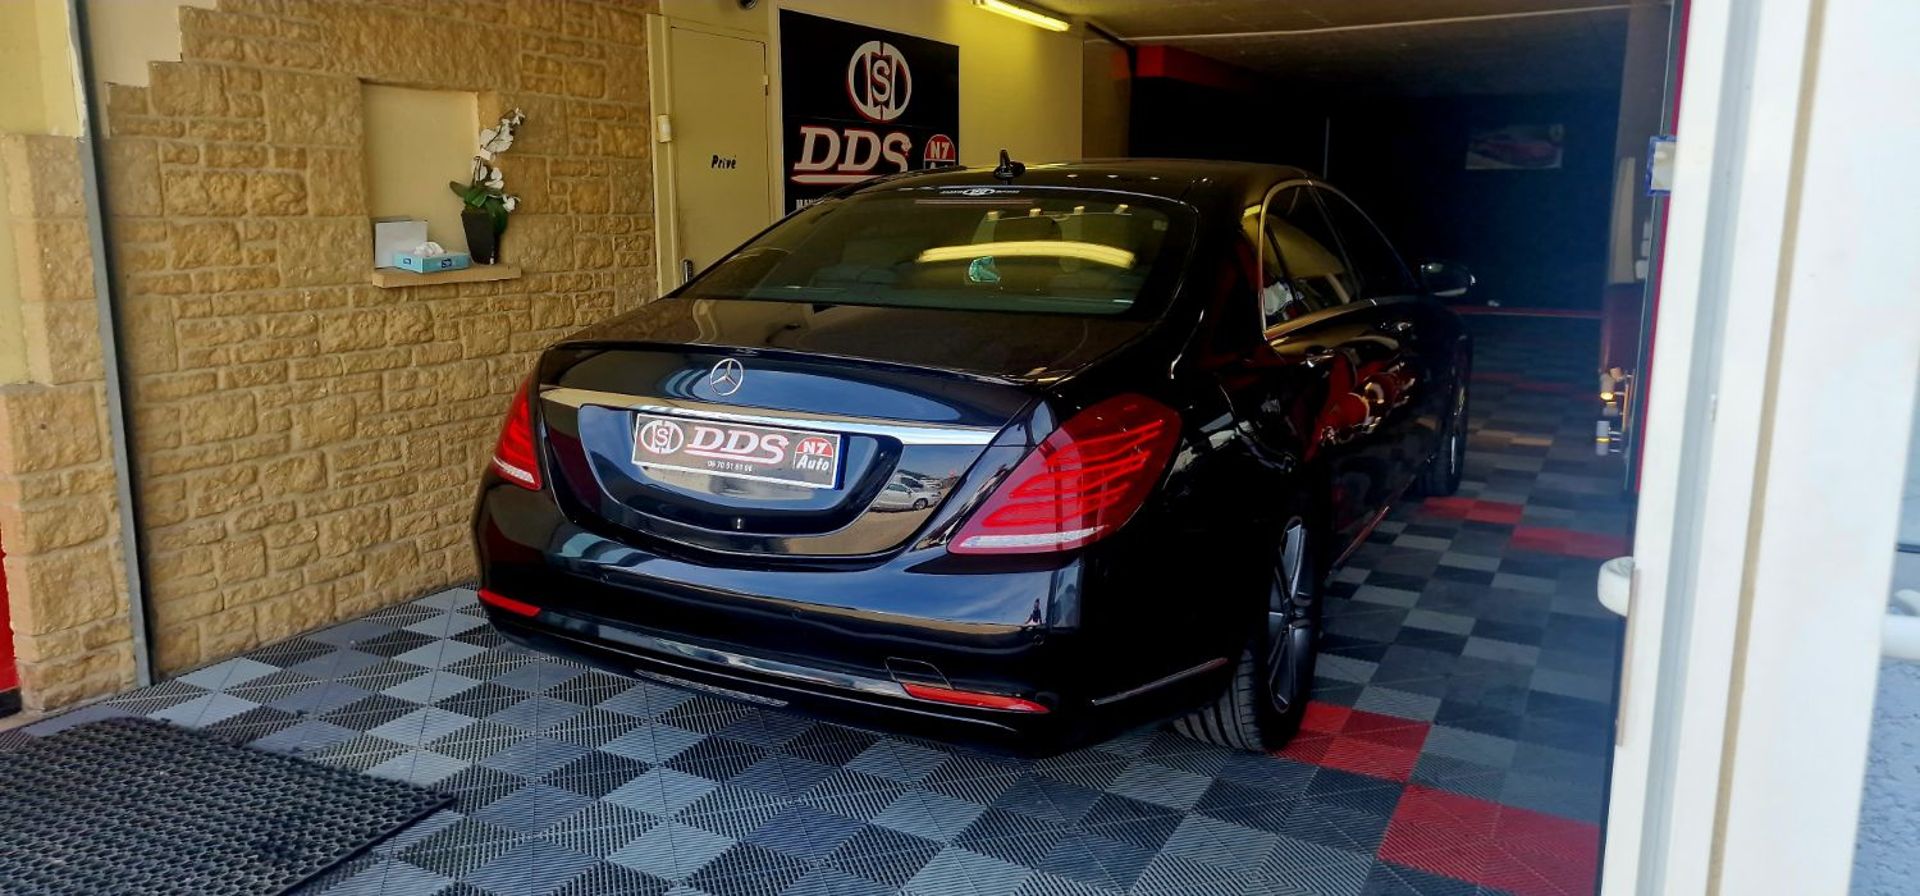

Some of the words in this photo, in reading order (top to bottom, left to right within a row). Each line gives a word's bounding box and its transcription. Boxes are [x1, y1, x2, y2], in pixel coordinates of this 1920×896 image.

[793, 126, 912, 172] DDS
[930, 140, 950, 160] N7
[711, 153, 737, 169] Privé
[686, 425, 789, 464] DDS
[802, 440, 828, 455] N7
[796, 454, 830, 471] Auto
